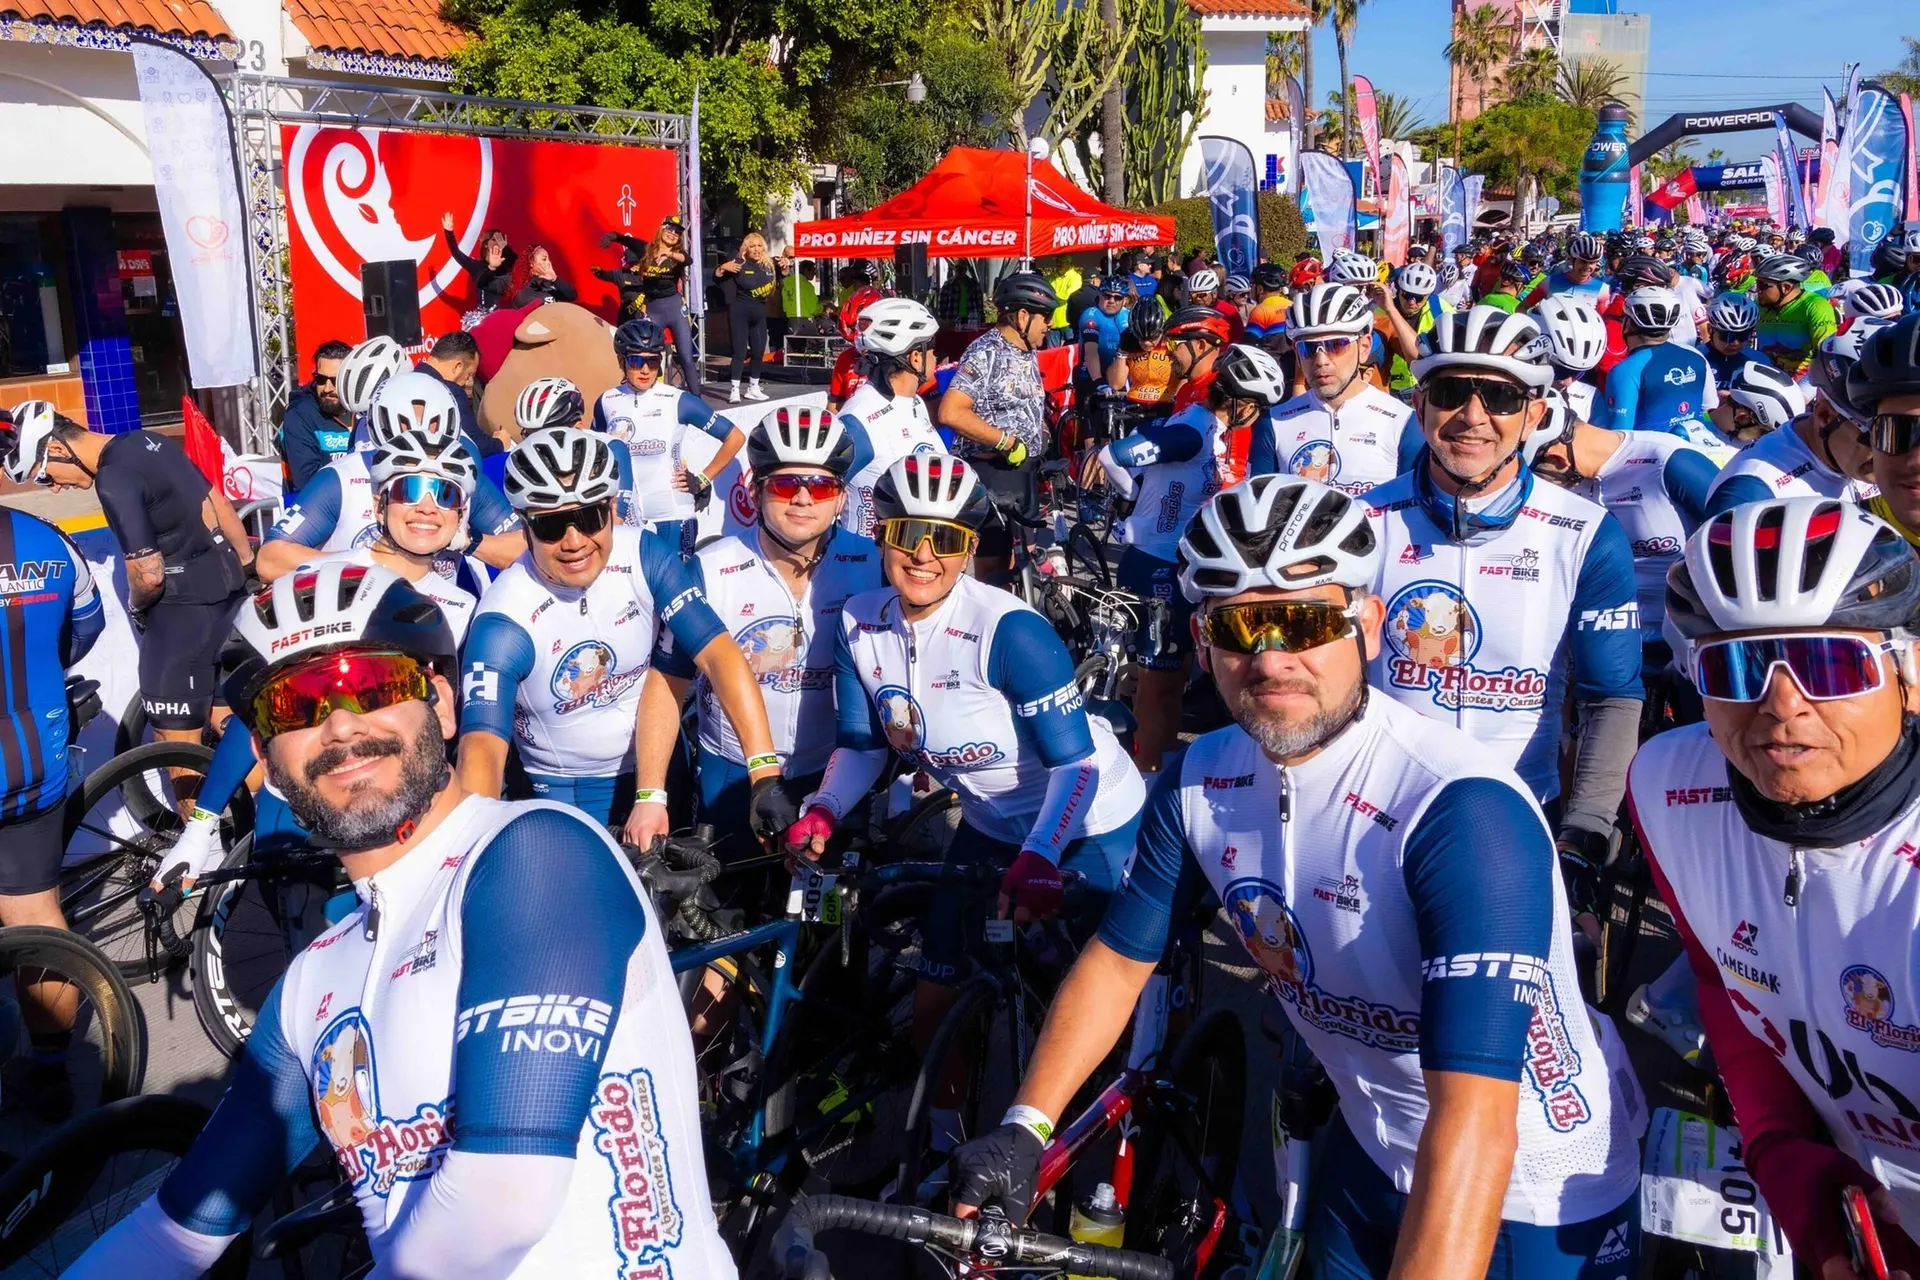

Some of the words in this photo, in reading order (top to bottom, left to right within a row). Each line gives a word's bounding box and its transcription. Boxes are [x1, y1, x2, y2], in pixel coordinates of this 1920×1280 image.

[800, 231, 837, 247] PRO
[841, 226, 896, 246] NIÑEZ
[901, 231, 931, 244] SIN
[936, 226, 1017, 246] CÁNCER
[1053, 226, 1076, 247] PRO
[1078, 219, 1108, 244] NIÑEZ
[1110, 222, 1125, 241] SIN
[1137, 393, 1160, 401] BEER
[1519, 505, 1588, 532] ASTBIKE
[0, 560, 68, 582] ANT
[720, 558, 756, 576] FASTBIKE
[1479, 566, 1540, 578] FASTBIKE
[0, 578, 44, 592] LANTIC
[1578, 601, 1640, 632] FAST
[271, 621, 352, 655] FASTBIKE
[944, 627, 979, 643] FASTBIKE
[1393, 658, 1428, 686] El
[1438, 665, 1545, 694] Florido
[1203, 773, 1255, 790] FASTBIKE
[1665, 786, 1734, 807] FASTBI
[1343, 791, 1399, 832] FASTBIKE
[1313, 888, 1360, 908] FASTBIKE
[1731, 939, 1759, 956] NOVO
[1716, 946, 1780, 994] CAMELBAK
[456, 994, 613, 1043] STBIKE
[599, 1081, 658, 1252] Florido
[1732, 1235, 1767, 1249] ELITE
[1594, 1249, 1631, 1265] NOVO
